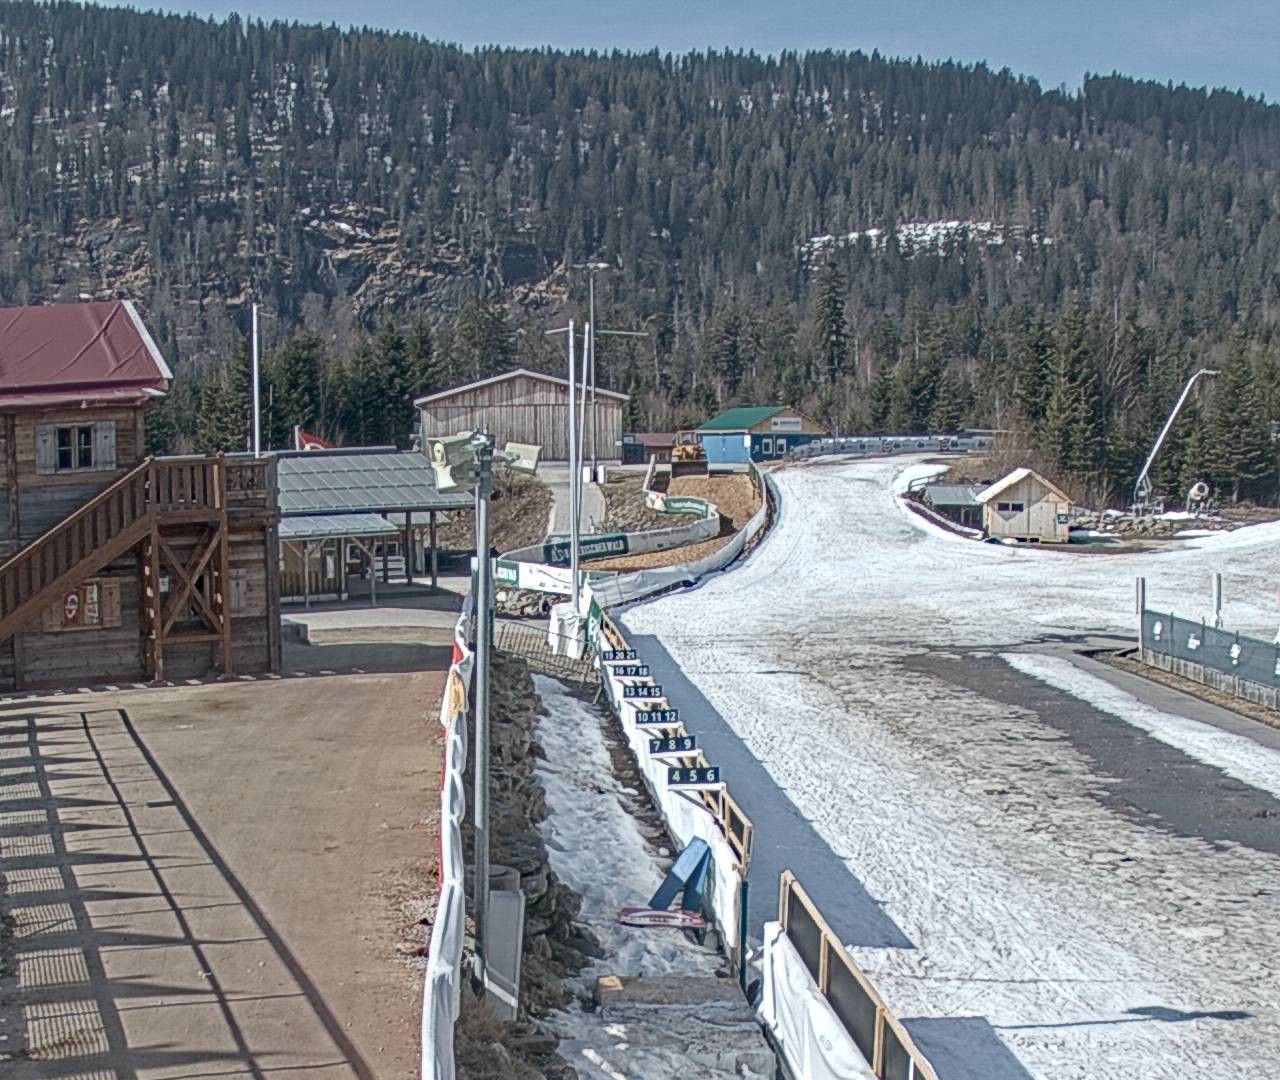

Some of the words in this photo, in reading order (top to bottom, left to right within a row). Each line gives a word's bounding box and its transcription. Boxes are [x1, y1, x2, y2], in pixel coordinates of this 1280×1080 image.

[625, 687, 635, 697] 13
[638, 687, 648, 697] 14
[650, 687, 661, 697] 15
[638, 712, 649, 722] 10
[651, 712, 662, 722] 11
[665, 711, 676, 722] 12
[653, 740, 661, 751] 7
[668, 739, 677, 750] 8
[683, 738, 692, 749] 9
[672, 770, 681, 781] 4
[689, 769, 698, 781] 5
[706, 769, 715, 781] 6
